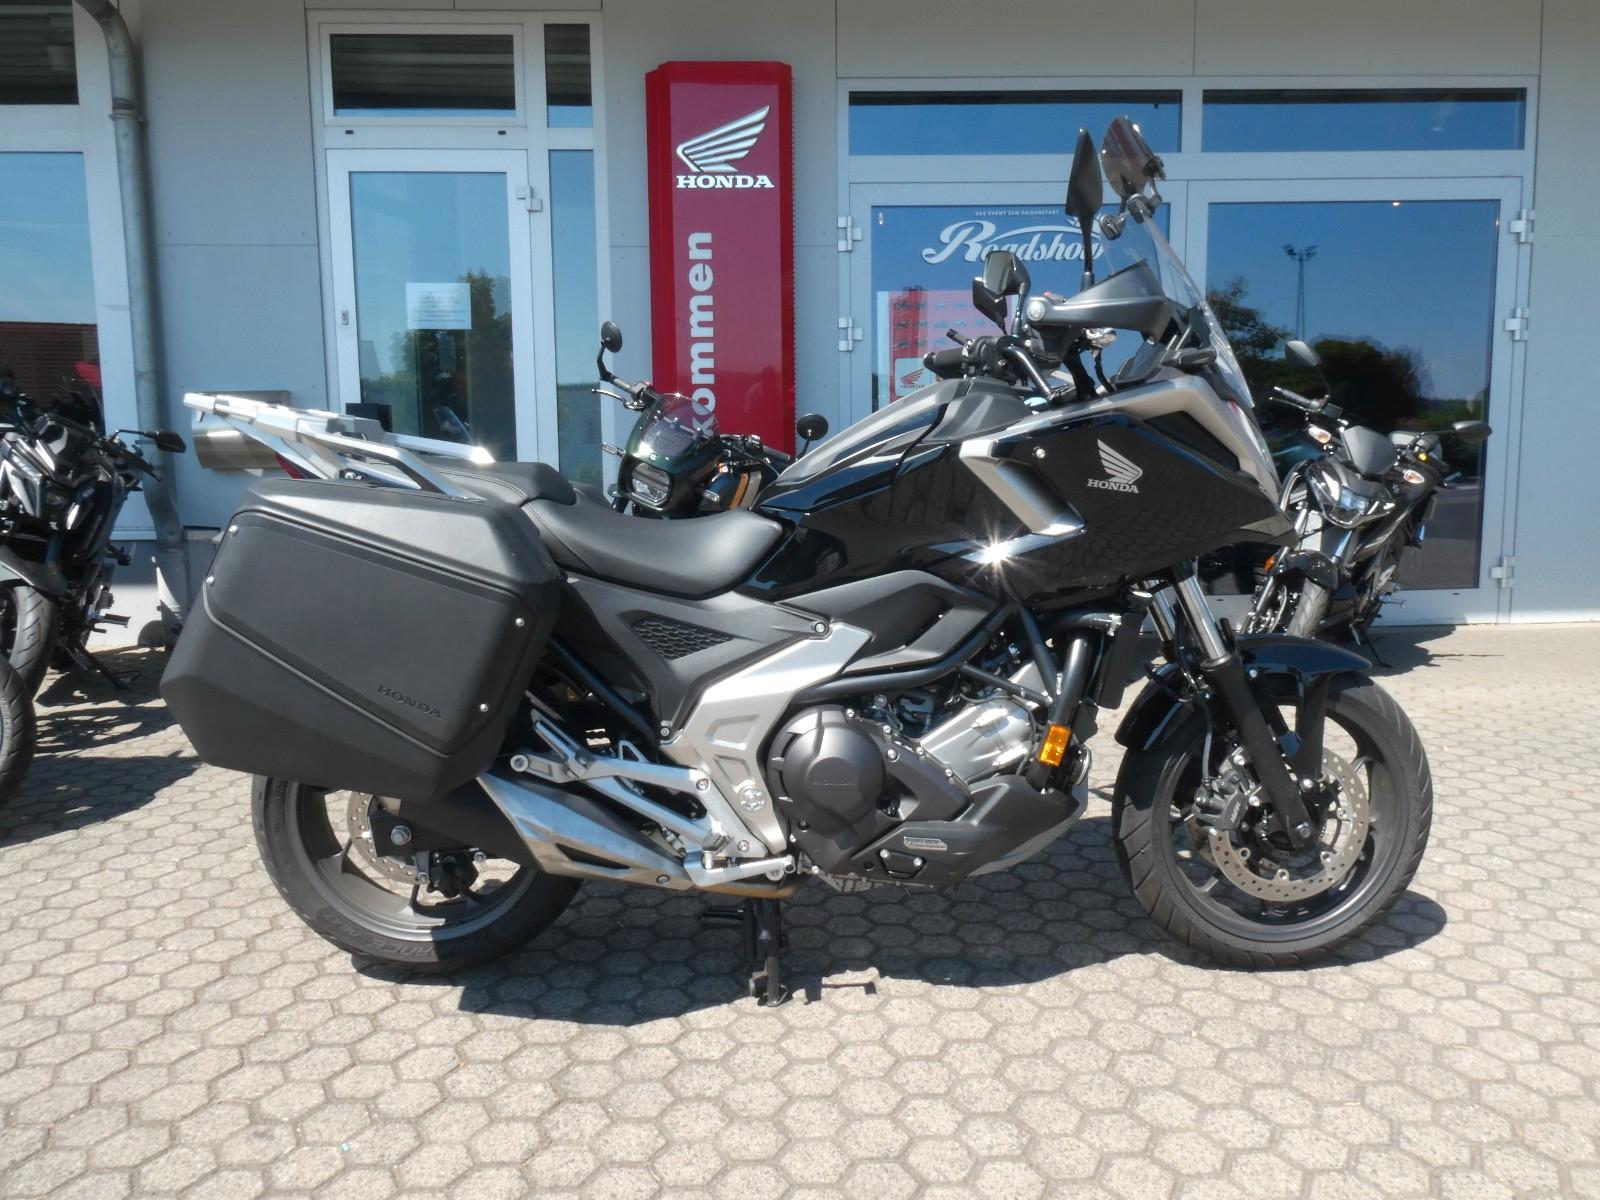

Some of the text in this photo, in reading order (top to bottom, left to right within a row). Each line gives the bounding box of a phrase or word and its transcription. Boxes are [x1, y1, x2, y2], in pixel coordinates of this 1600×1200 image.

[676, 175, 774, 189] HONDA
[1087, 479, 1139, 494] HONDA
[378, 685, 442, 720] HONDA
